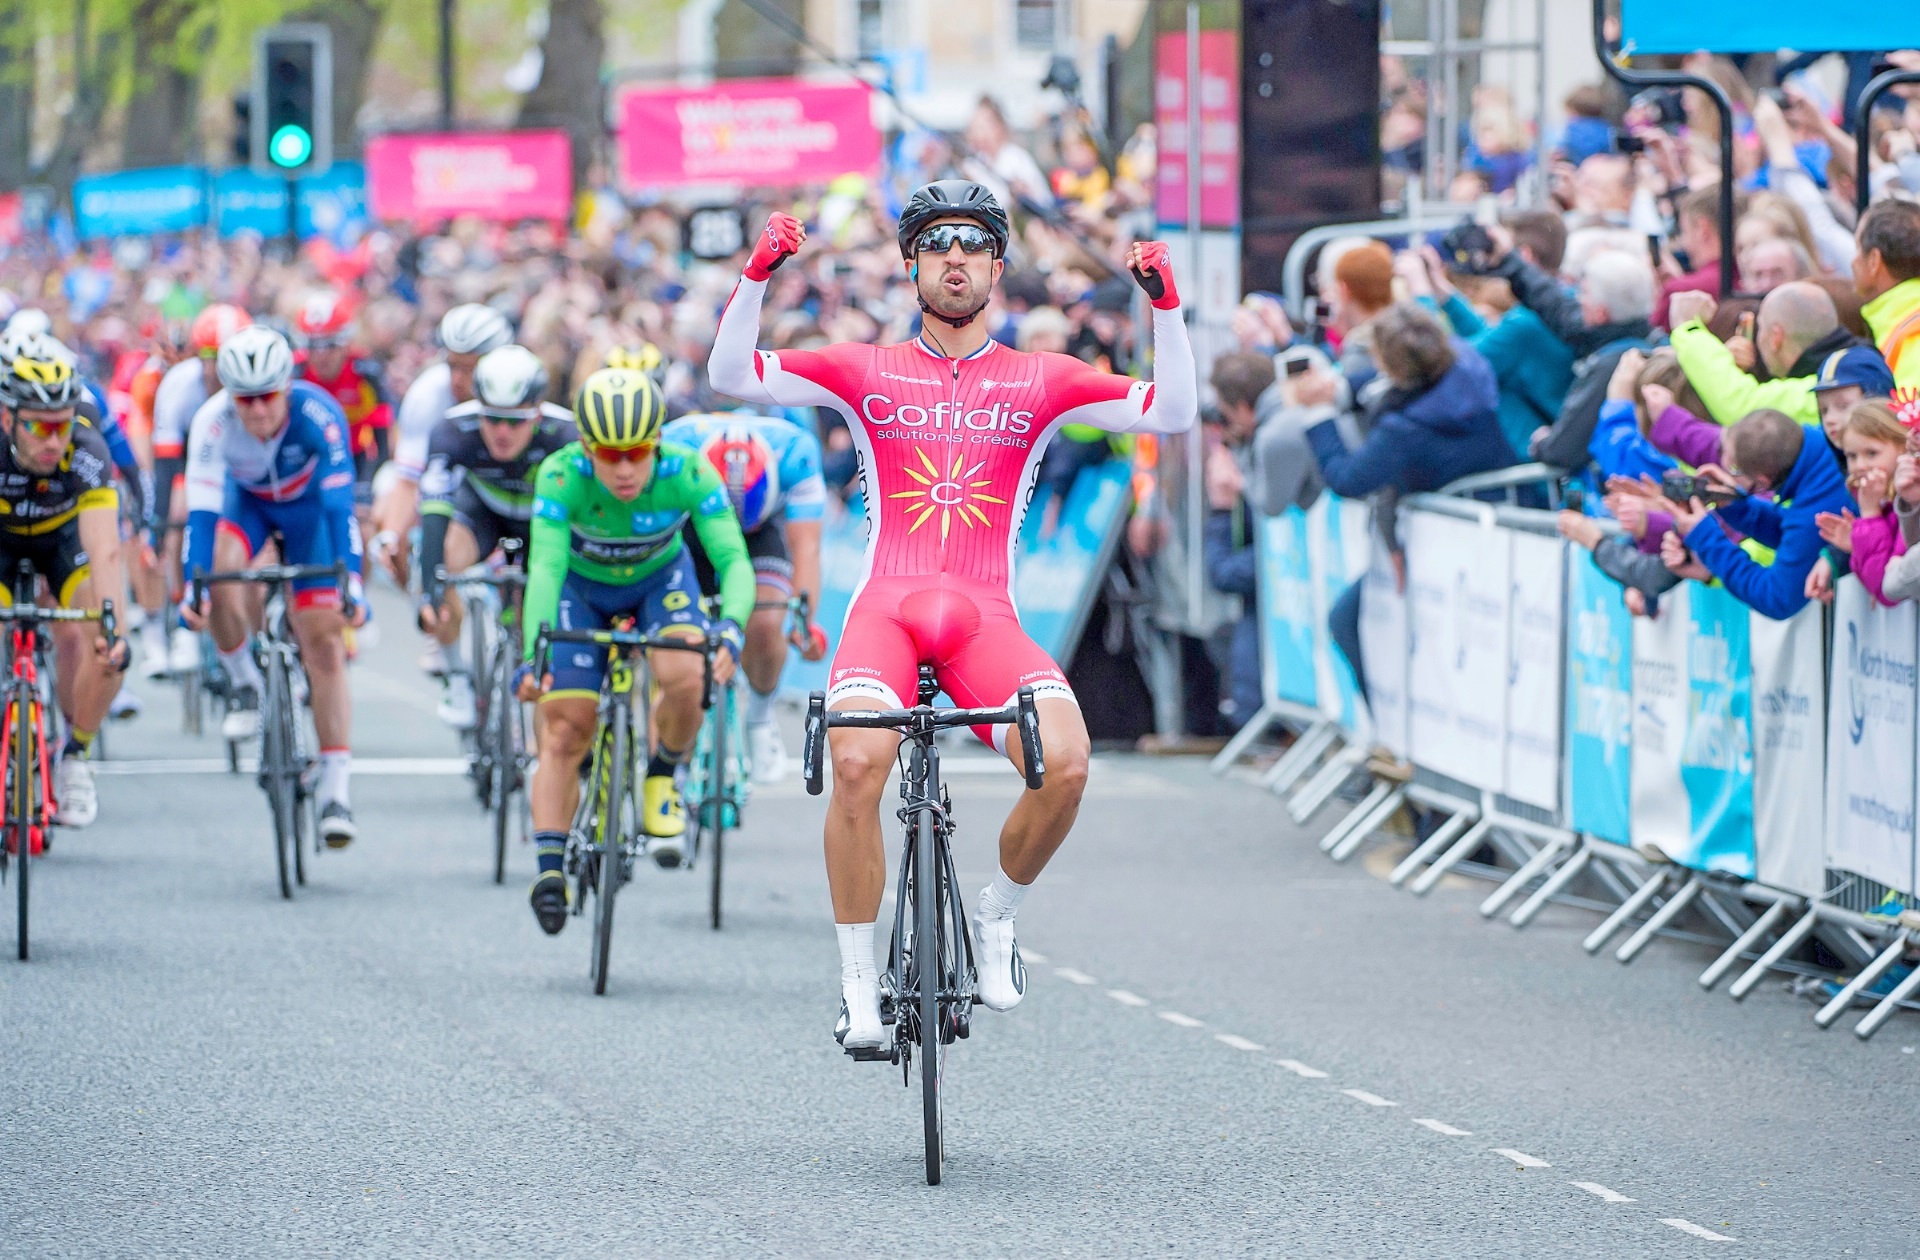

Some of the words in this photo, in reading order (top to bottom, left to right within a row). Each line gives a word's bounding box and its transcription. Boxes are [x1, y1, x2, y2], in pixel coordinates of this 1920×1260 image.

[880, 371, 943, 387] ORBEA
[1000, 378, 1033, 388] Nalini
[861, 393, 1034, 435] Cofidis
[877, 428, 964, 443] solutions
[970, 433, 1029, 449] crédits
[849, 666, 882, 677] Nalini
[1019, 669, 1050, 683] Nalini
